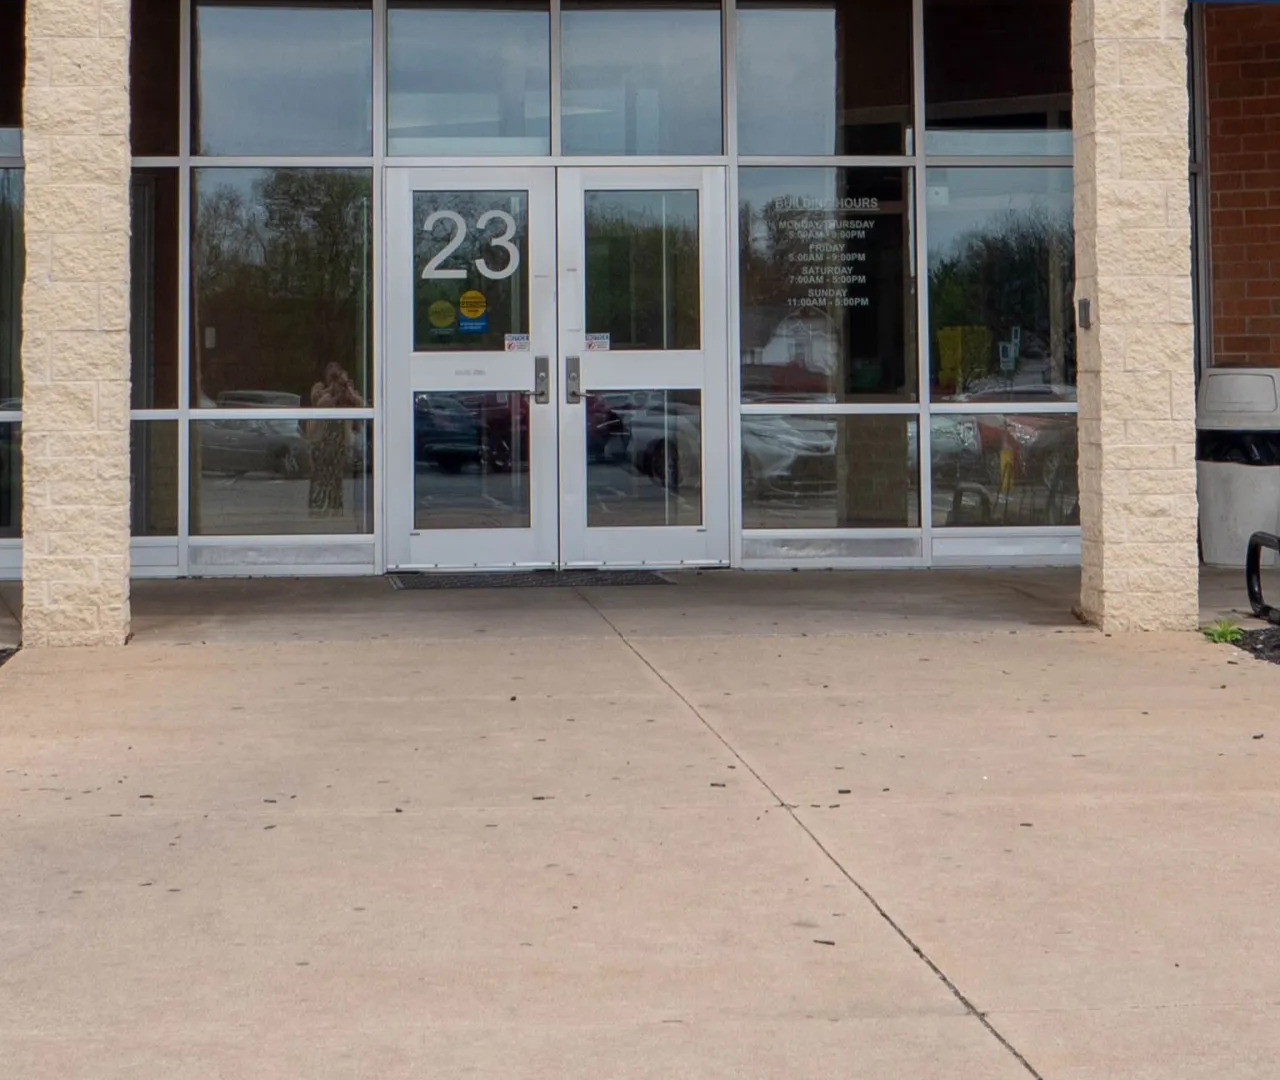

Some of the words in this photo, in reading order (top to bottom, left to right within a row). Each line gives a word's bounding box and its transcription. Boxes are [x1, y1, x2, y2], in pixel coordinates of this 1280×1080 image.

[775, 197, 834, 209] BUILDING
[836, 197, 879, 209] HOURS
[421, 209, 520, 280] 23
[808, 243, 846, 253] FRIDAY
[801, 266, 854, 275] SATURDAY
[789, 275, 824, 284] 7:00AM
[808, 289, 848, 298] SUNDAY
[787, 298, 827, 307] 11:00AM
